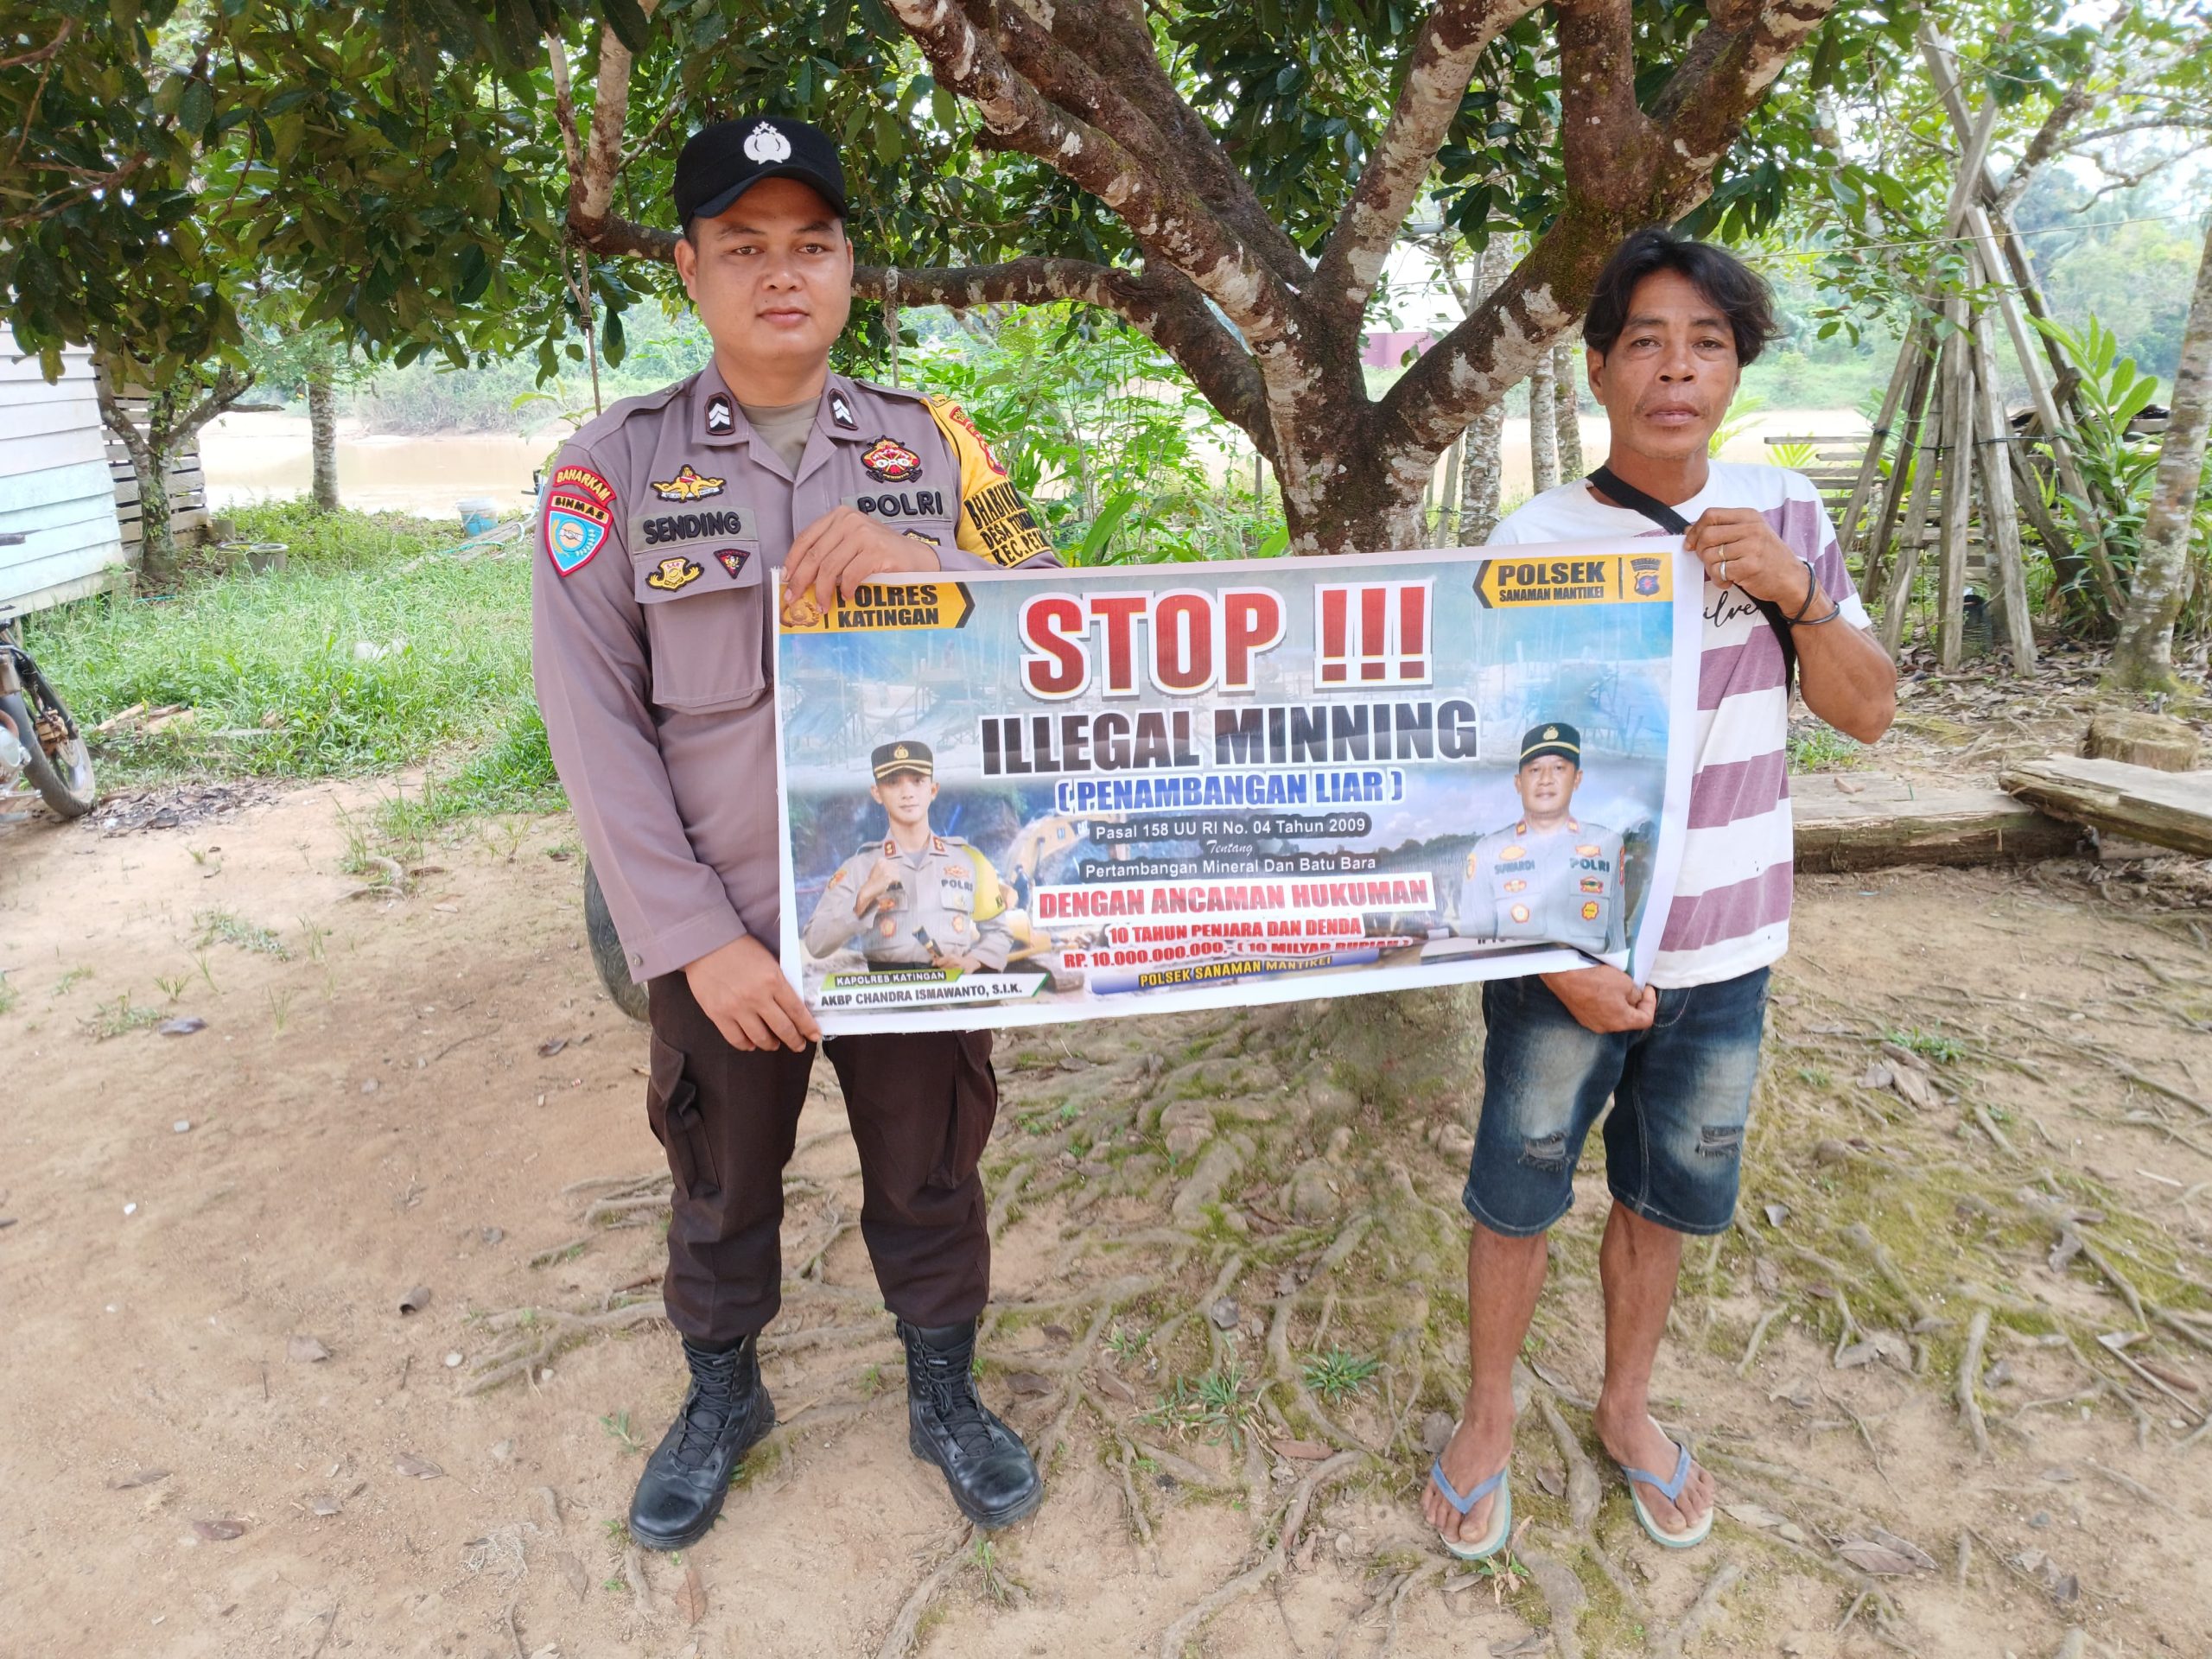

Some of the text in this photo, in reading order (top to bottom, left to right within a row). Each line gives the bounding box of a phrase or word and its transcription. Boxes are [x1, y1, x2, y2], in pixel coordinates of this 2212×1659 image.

[556, 469, 611, 501] BAHARKAM
[555, 497, 605, 520] BINMAS
[857, 491, 944, 517] POLRI
[643, 511, 741, 544] SENDING
[980, 522, 1014, 550] DESA
[1497, 562, 1605, 587] POLSEK
[1499, 586, 1604, 602] SANAMAN MANTIKEI
[837, 608, 939, 628] KATINGAN
[1023, 592, 1281, 696] STOP
[982, 700, 1478, 775] ILLEGAL MINNING
[1096, 817, 1366, 840] Pasal 158 UU RI No. 04 Tahun 2009
[1205, 839, 1254, 856] Tentang
[1085, 856, 1376, 878] Pertambangan Mineral Dan Batu Bara
[1569, 857, 1610, 873] POLRI
[941, 879, 974, 892] POLRI
[1039, 880, 1429, 919] DENGAN ANCAMAN HUKUMAN
[1109, 918, 1363, 944] 10 TAHUN PENJARA DAN DENDA
[1064, 953, 1088, 969] RP.
[1139, 956, 1332, 988] POLSEK SANAMAN MANTIKEI
[836, 971, 945, 987] KAPOLRES KATINGAN
[821, 983, 1023, 1007] AKBP CHANDRA ISMAWANTO, S.I.K.
